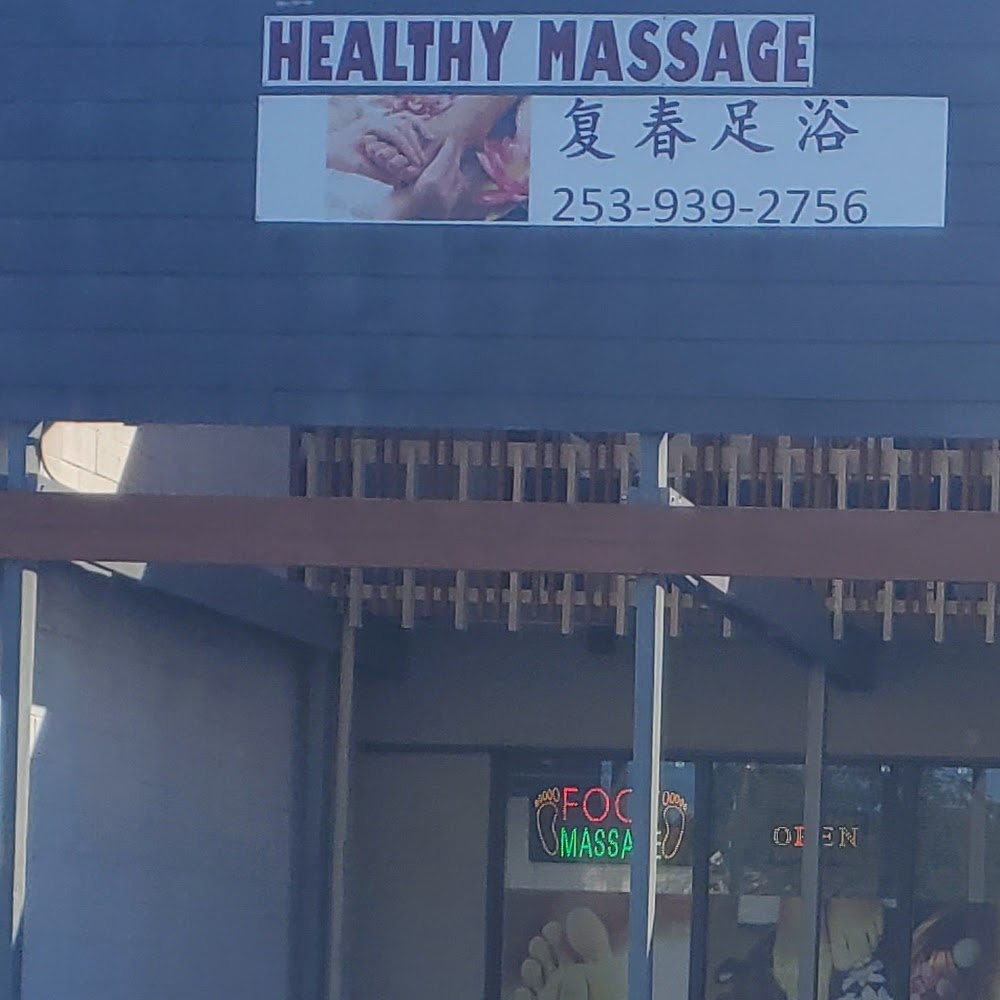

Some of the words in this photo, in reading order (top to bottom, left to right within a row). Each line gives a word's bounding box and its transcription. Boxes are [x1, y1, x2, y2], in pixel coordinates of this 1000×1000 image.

[267, 20, 513, 82] HEALTHY
[537, 19, 811, 83] MASSAGE
[558, 97, 860, 160] 复春足浴
[551, 187, 869, 225] 253-939-2756
[562, 786, 657, 824] FOO
[560, 827, 662, 860] MASSA
